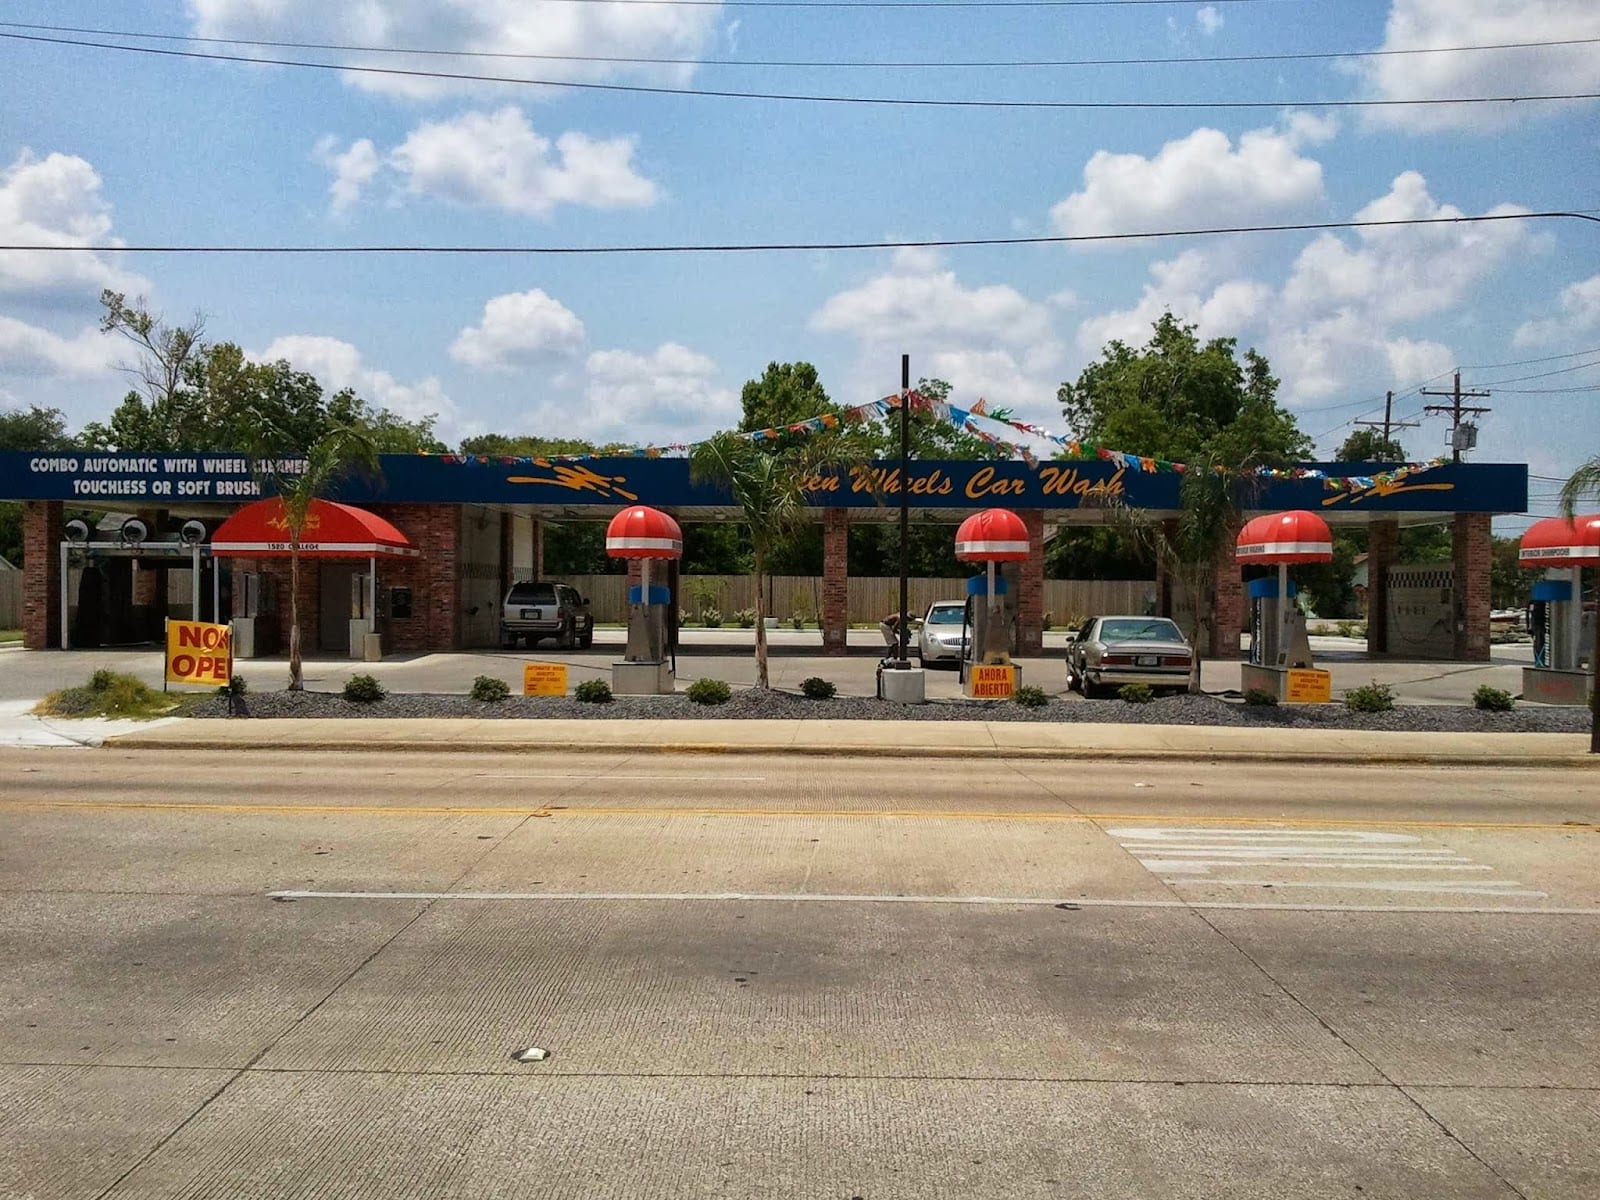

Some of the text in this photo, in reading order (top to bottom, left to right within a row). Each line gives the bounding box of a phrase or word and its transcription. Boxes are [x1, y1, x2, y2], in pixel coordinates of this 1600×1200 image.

[30, 458, 78, 473] COMBO
[83, 458, 158, 473] AUTOMATIC
[163, 458, 197, 473] WITH
[202, 458, 247, 473] WHEEL
[73, 479, 261, 495] TOUCHLESS OR SOFT BRUSH
[849, 465, 953, 494] Whels
[965, 466, 1025, 499] Car
[1039, 467, 1125, 495] Wash
[172, 654, 229, 679] OPE
[979, 668, 1007, 681] AHORA
